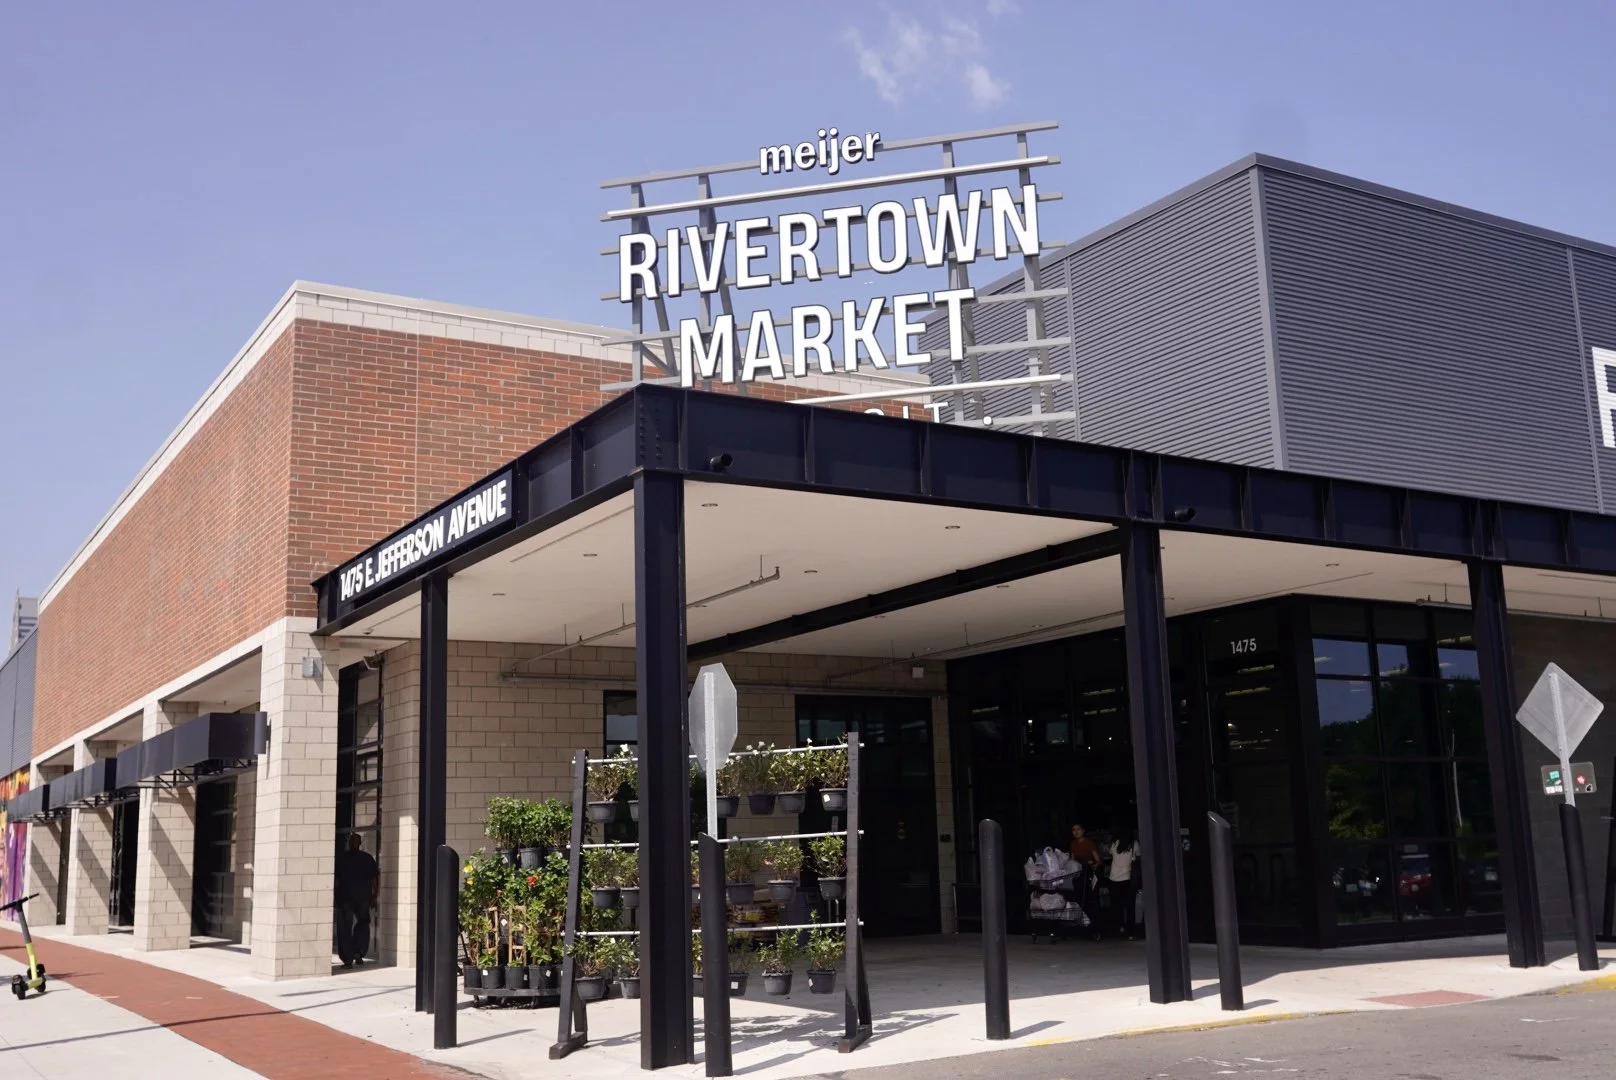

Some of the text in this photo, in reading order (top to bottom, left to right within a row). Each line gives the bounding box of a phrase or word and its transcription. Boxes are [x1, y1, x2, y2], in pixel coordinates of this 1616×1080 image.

[759, 127, 880, 174] meijer
[618, 184, 1040, 302] RIVERTOWN
[680, 288, 975, 388] MARKET
[341, 563, 363, 601] 1475
[375, 516, 444, 582] JEFFERSON
[447, 480, 507, 543] AVENUE
[1230, 638, 1257, 654] 1475
